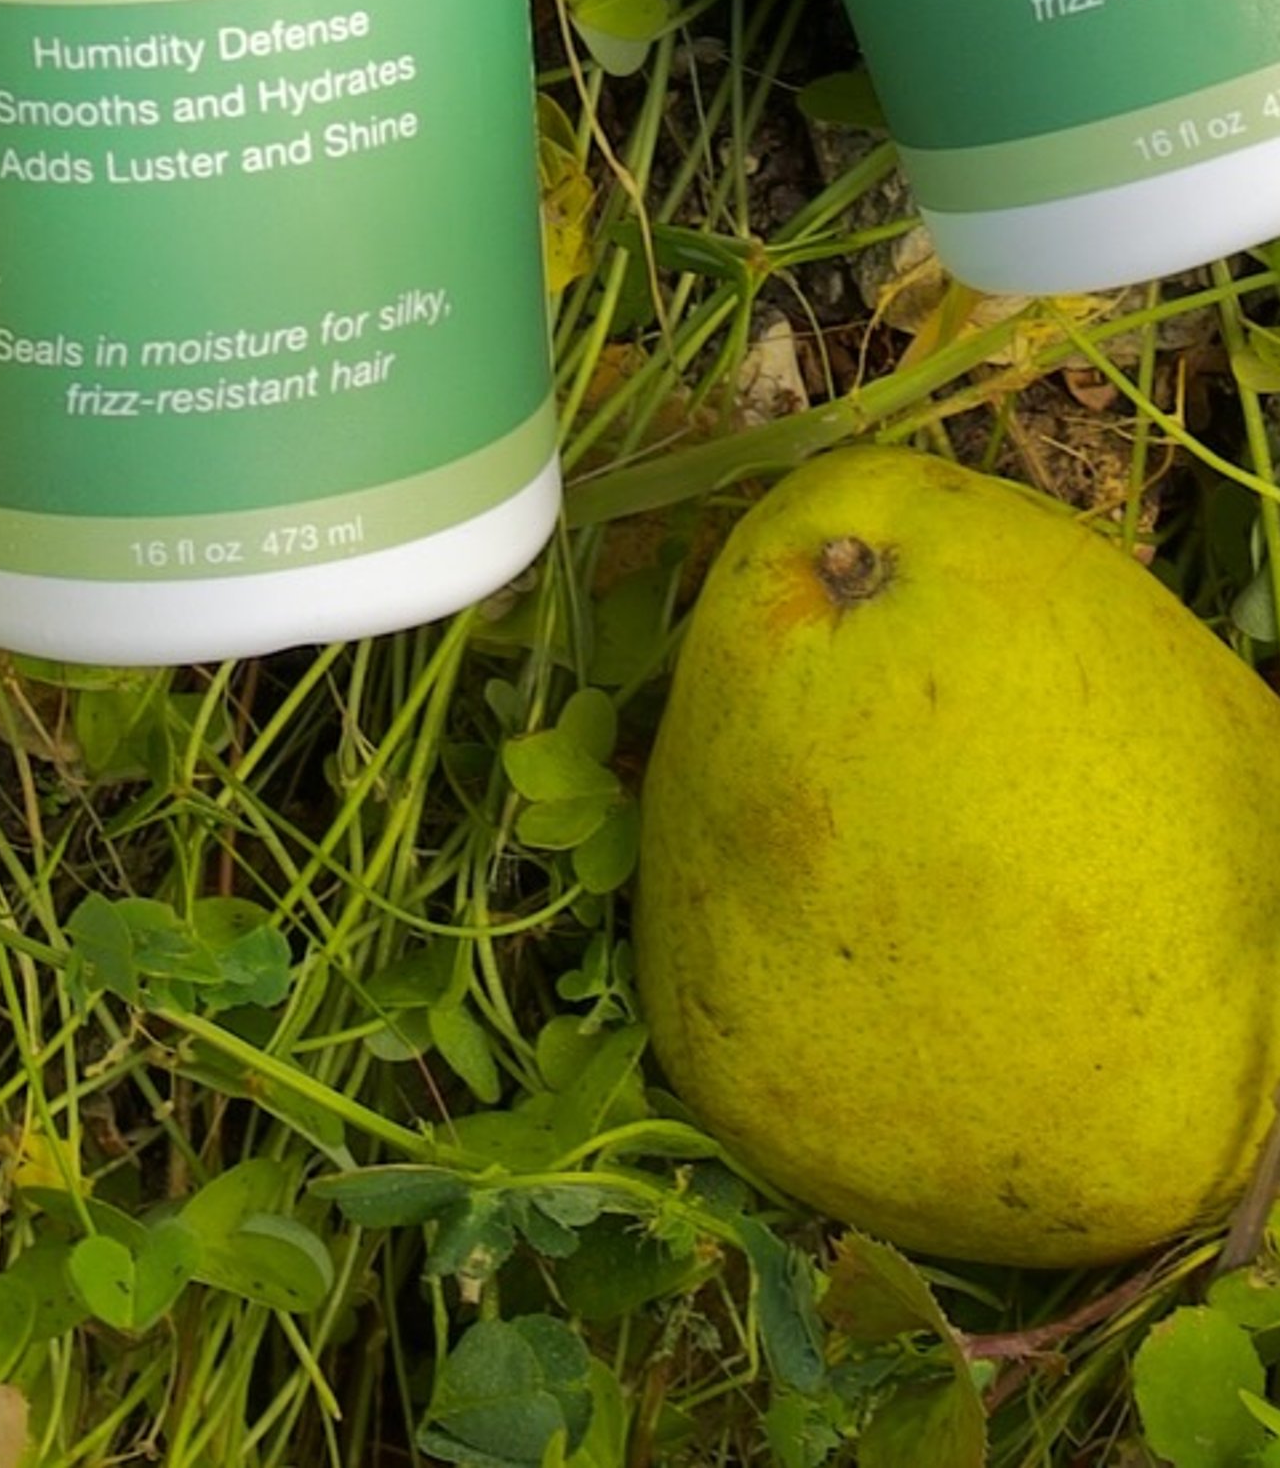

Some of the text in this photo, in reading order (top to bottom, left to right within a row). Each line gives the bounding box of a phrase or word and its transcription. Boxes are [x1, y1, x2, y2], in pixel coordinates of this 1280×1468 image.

[33, 10, 369, 72] Humidity Defense
[172, 85, 246, 124] and
[258, 54, 416, 123] Hydrates
[107, 144, 228, 184] Luster
[242, 131, 312, 172] and
[325, 107, 418, 160] Shine
[1134, 130, 1173, 162] 16
[1180, 119, 1201, 148] fl
[1207, 113, 1247, 141] oz
[95, 334, 128, 367] in
[140, 325, 308, 367] moisture
[320, 311, 366, 347] for
[378, 286, 453, 333] silky,
[65, 351, 397, 418] frizz-resistant hair
[129, 516, 365, 567] 16 fl oz 473 ml
